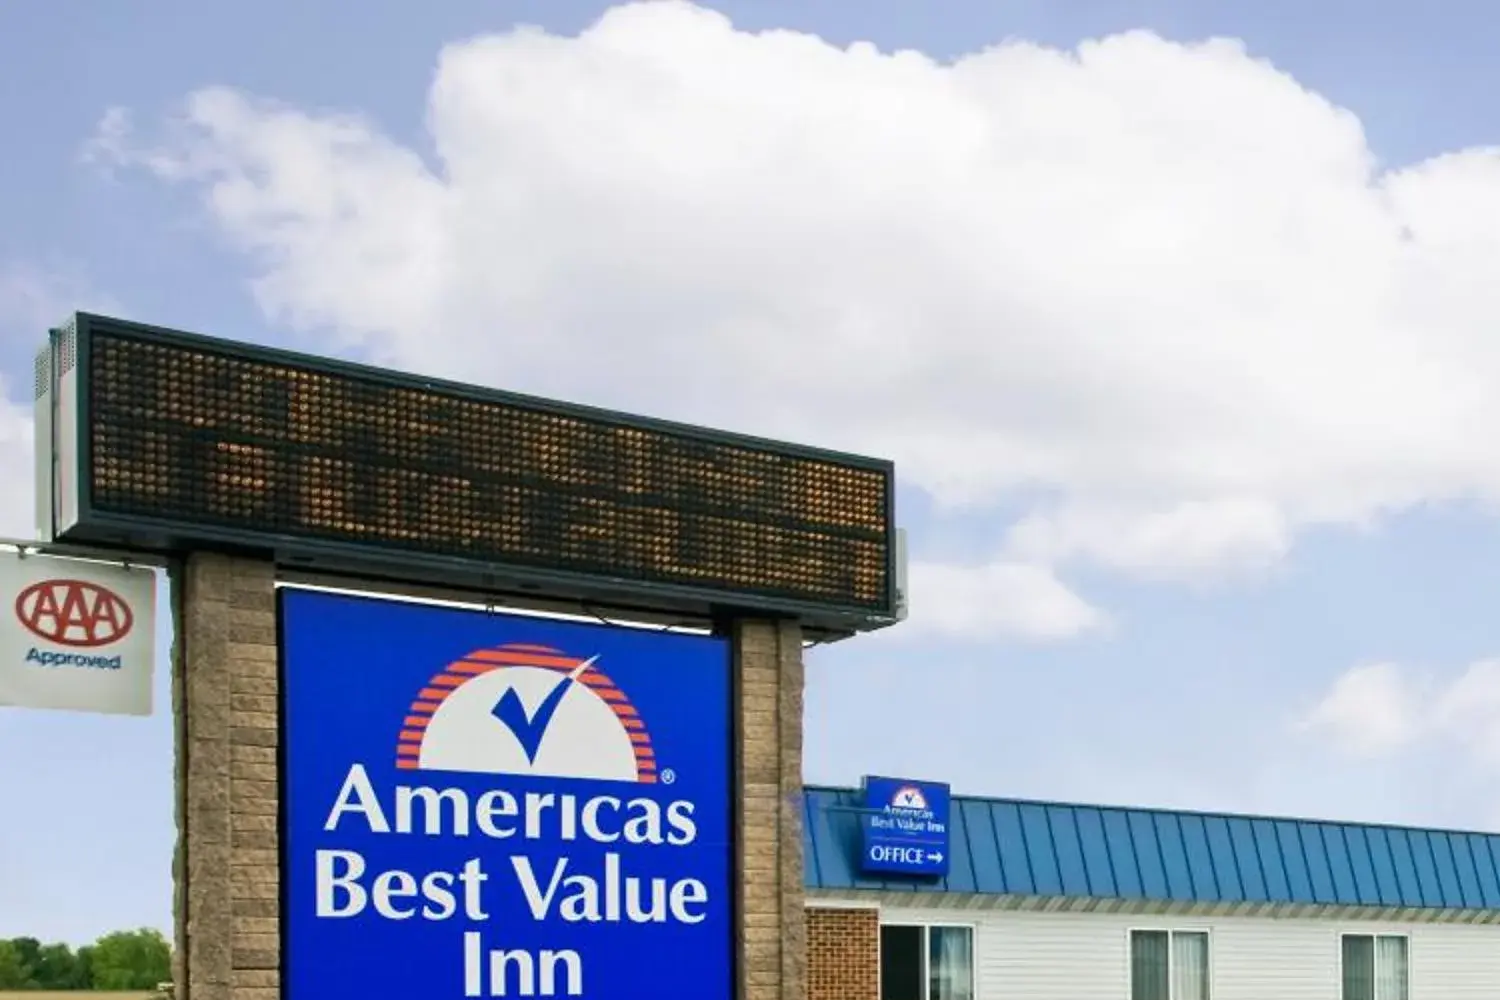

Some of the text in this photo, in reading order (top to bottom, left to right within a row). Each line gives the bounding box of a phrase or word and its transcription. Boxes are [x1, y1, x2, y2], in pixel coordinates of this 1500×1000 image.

[27, 582, 123, 645] AAA
[26, 648, 121, 669] Approved
[324, 763, 697, 845] Americas
[316, 849, 708, 924] Best Value
[870, 845, 924, 864] OFFICE
[464, 932, 583, 997] Inn
